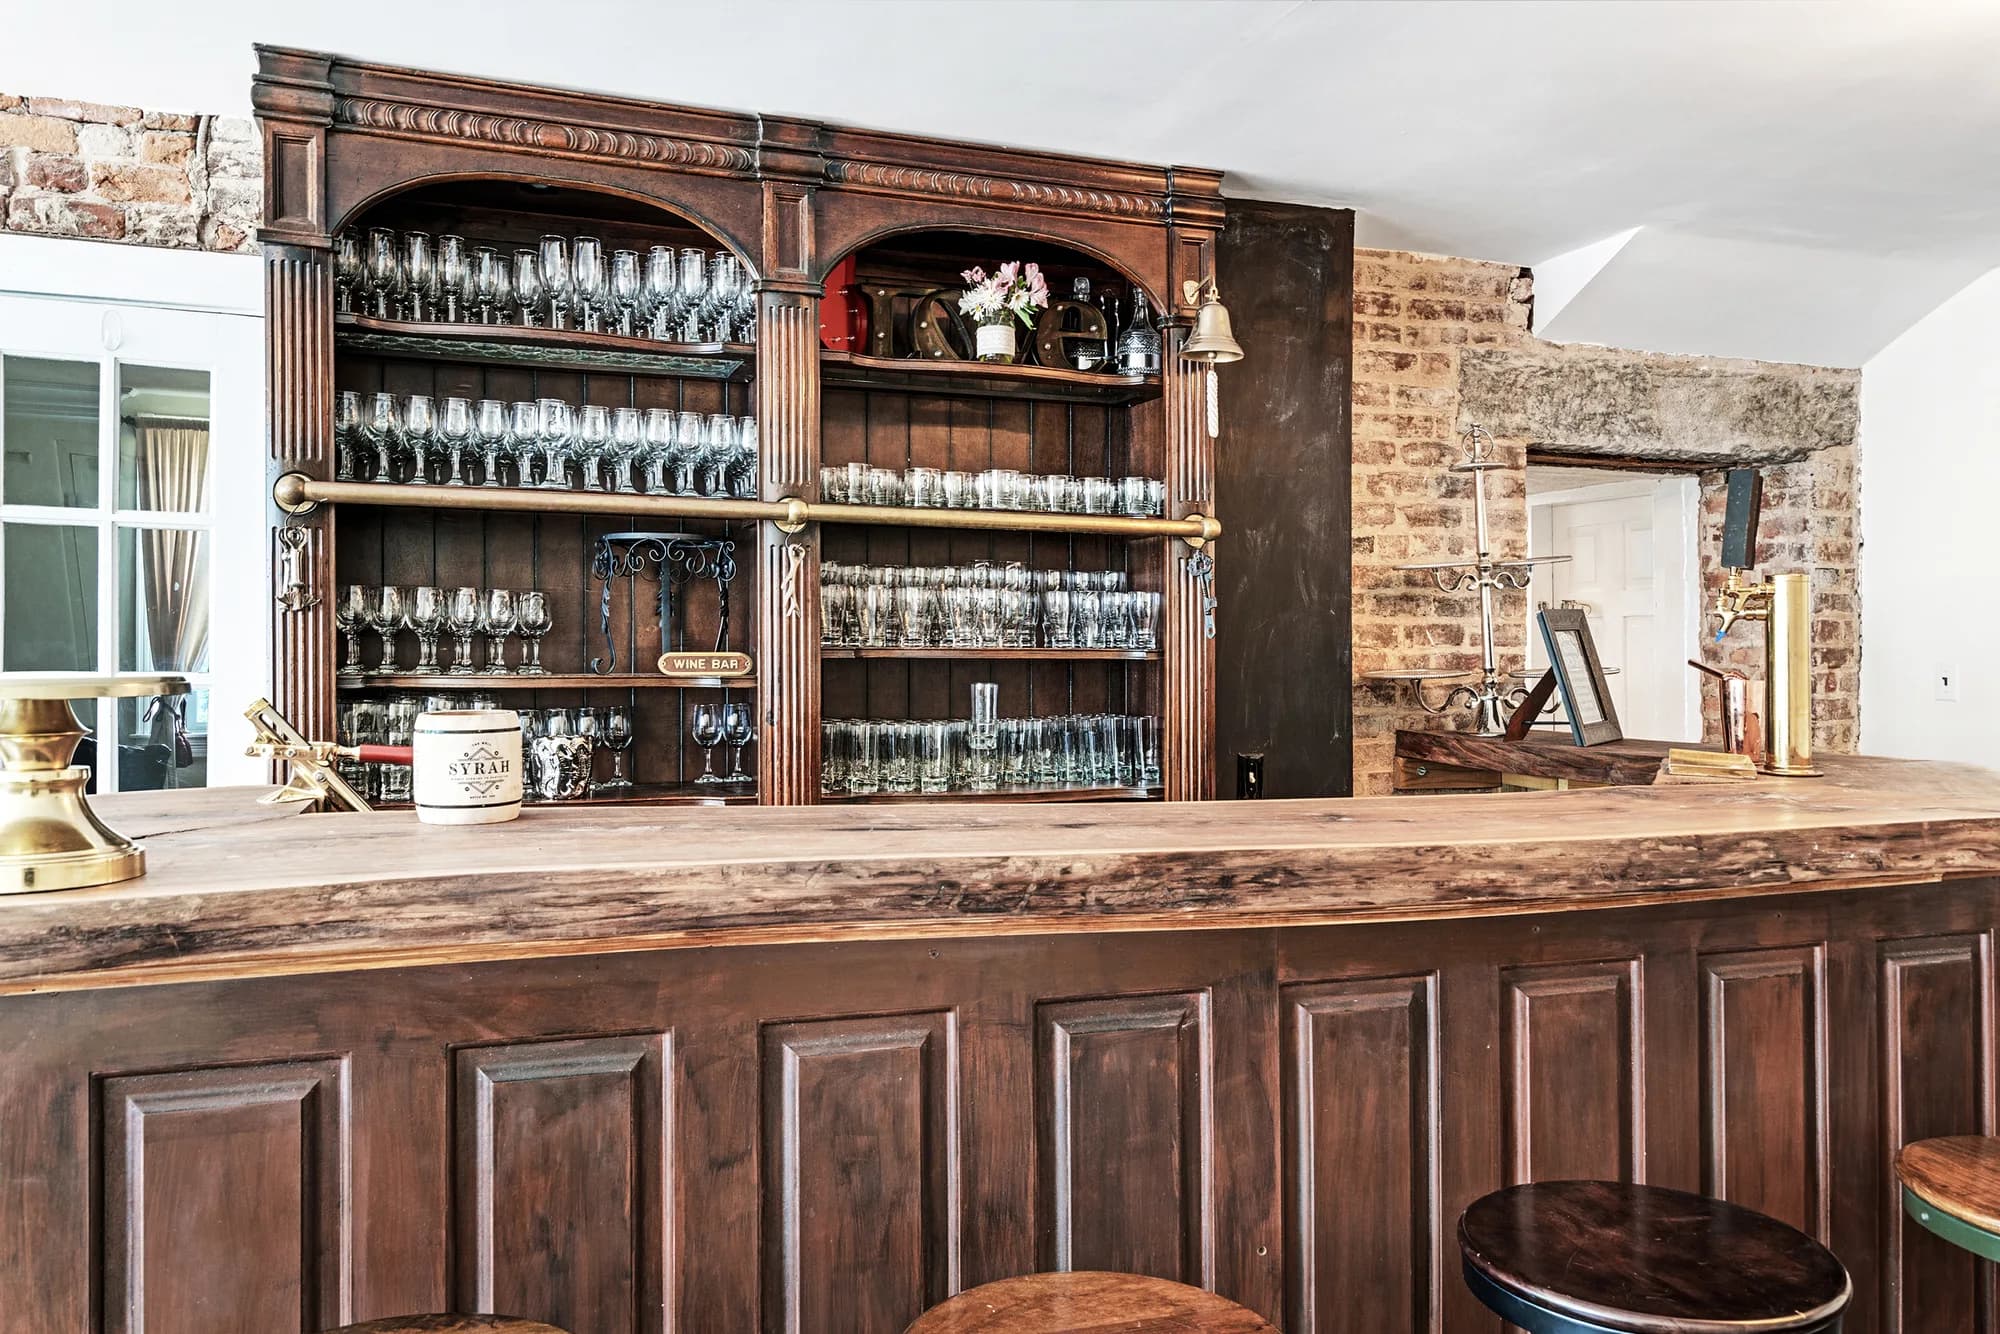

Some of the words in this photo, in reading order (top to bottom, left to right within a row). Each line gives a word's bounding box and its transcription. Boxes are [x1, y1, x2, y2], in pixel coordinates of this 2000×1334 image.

[673, 659, 706, 669] WINE
[711, 659, 738, 669] BAR
[448, 760, 510, 776] SYRAH
